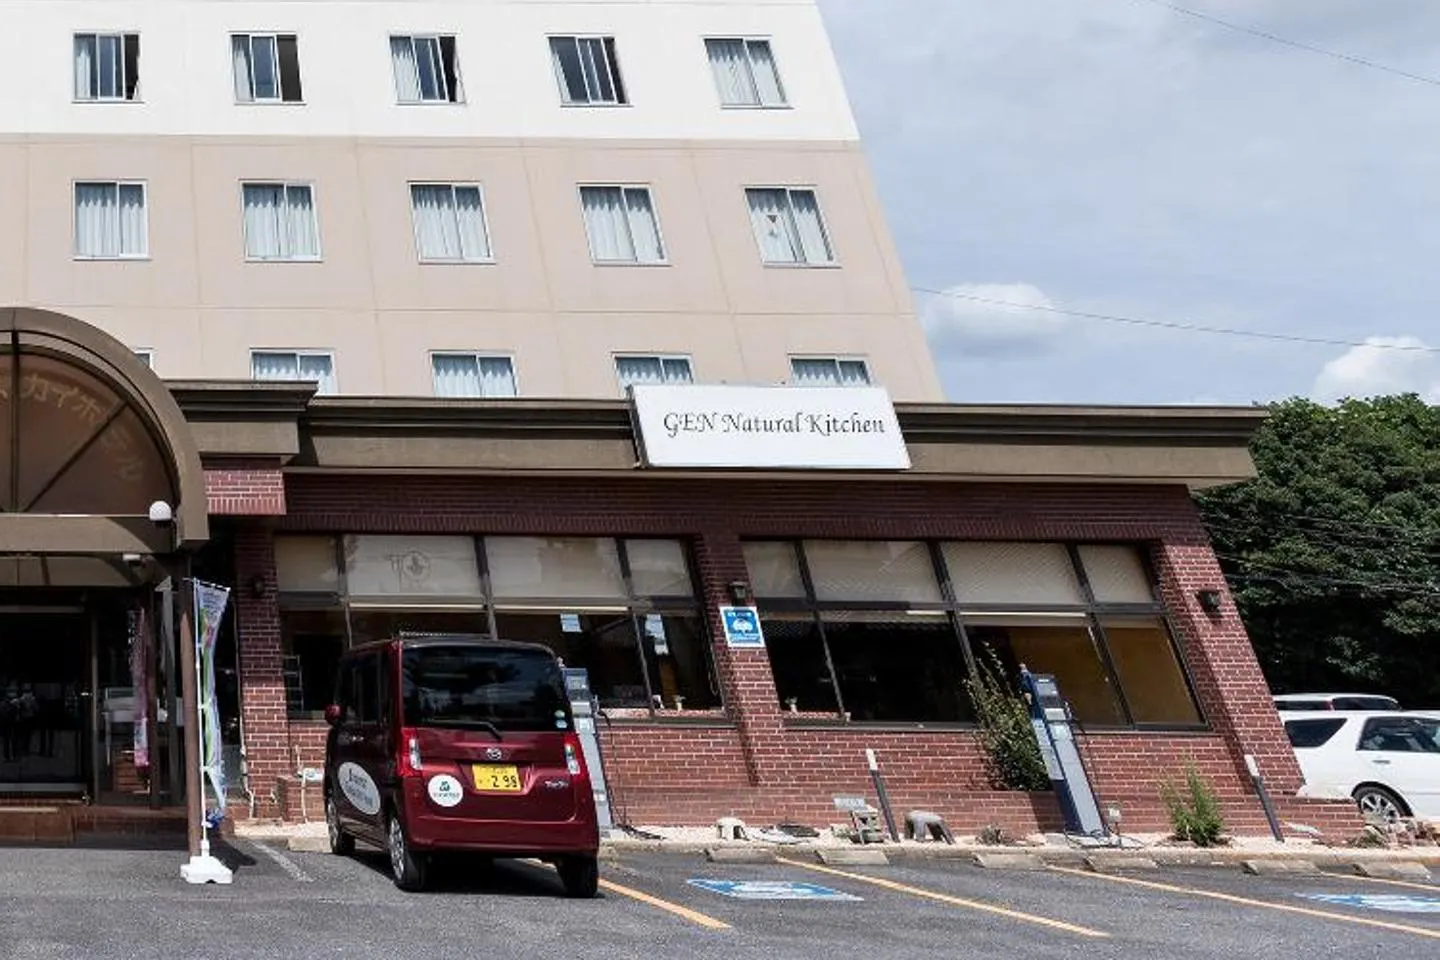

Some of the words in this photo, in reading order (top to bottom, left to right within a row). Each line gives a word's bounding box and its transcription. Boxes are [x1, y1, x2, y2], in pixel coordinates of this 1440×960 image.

[663, 411, 717, 437] GEN
[721, 411, 803, 434] Natural
[804, 412, 886, 436] Kitchen
